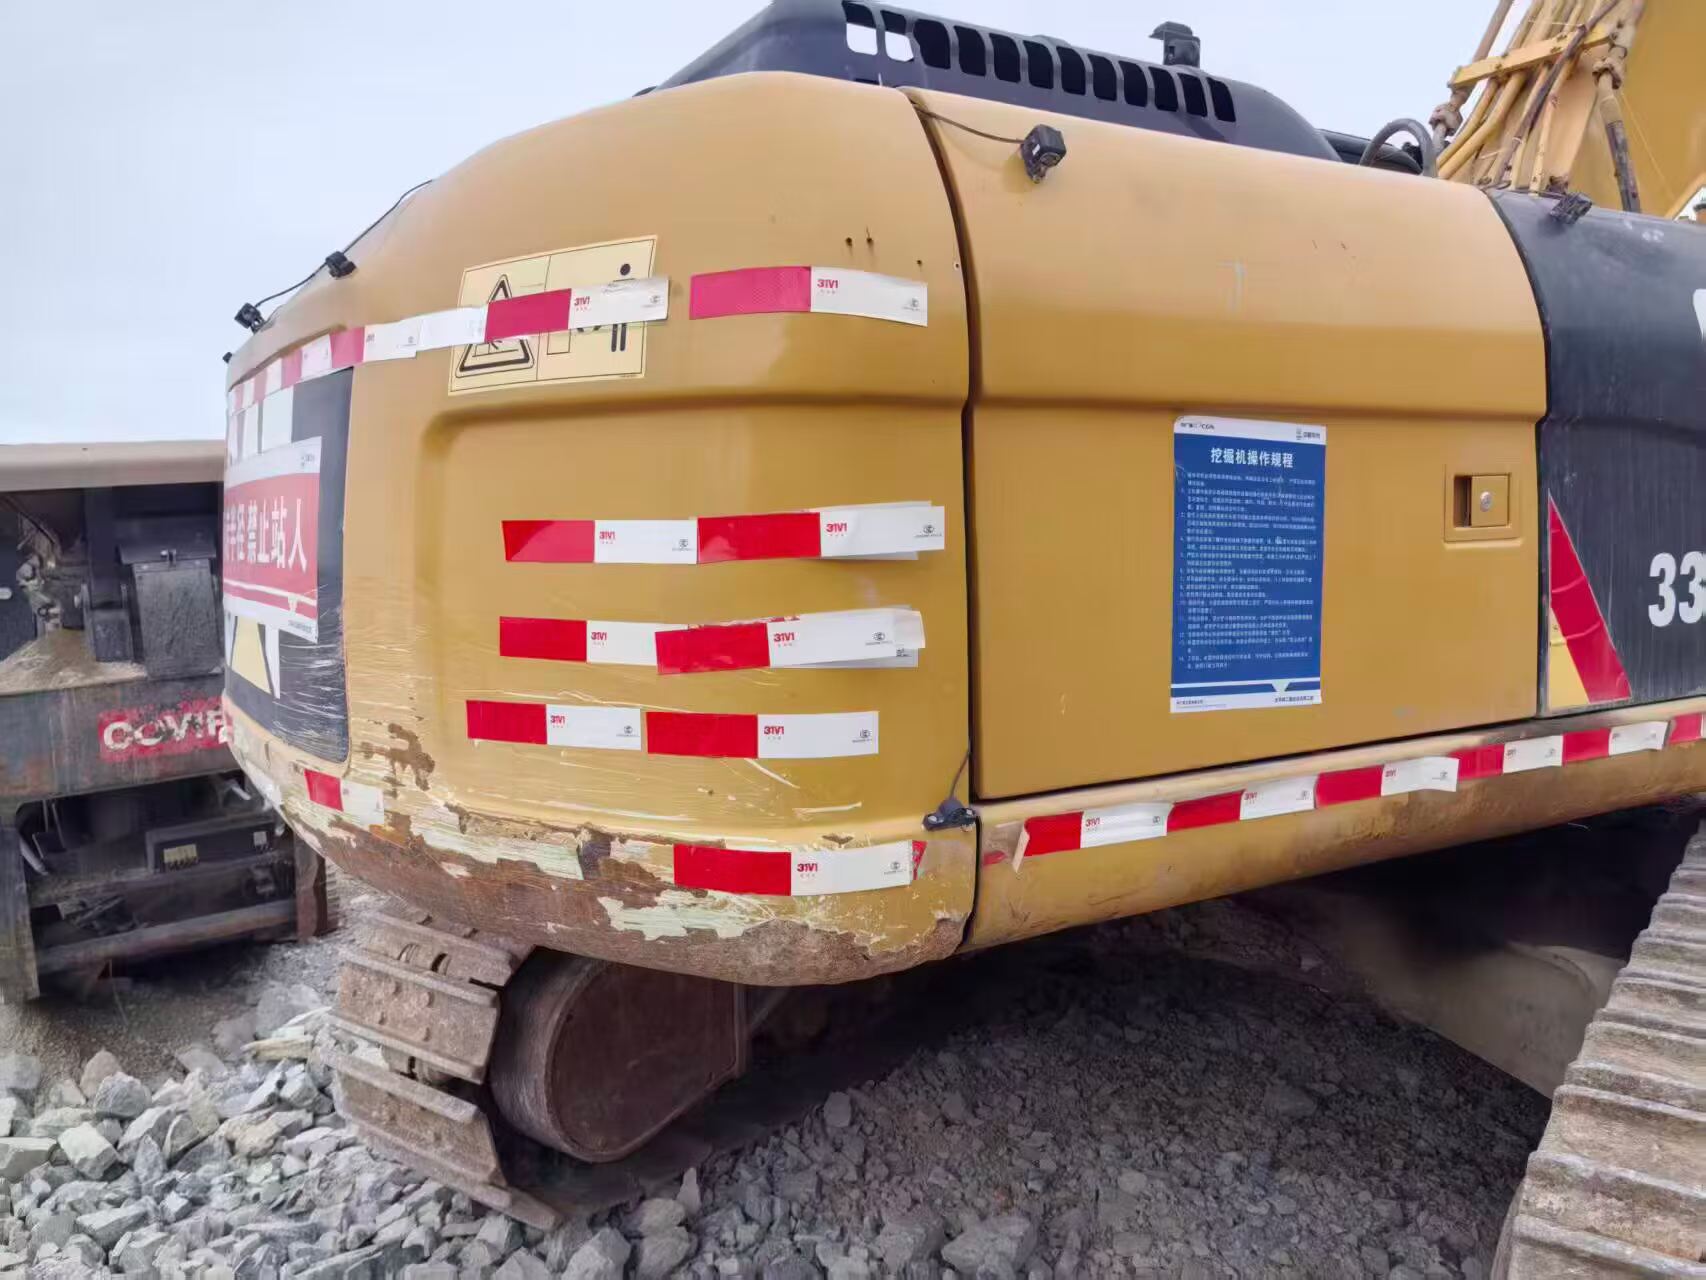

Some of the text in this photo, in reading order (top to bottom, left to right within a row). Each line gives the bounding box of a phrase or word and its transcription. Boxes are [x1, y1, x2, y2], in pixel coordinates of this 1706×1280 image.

[1210, 447, 1294, 469] 挖掘机操作规程
